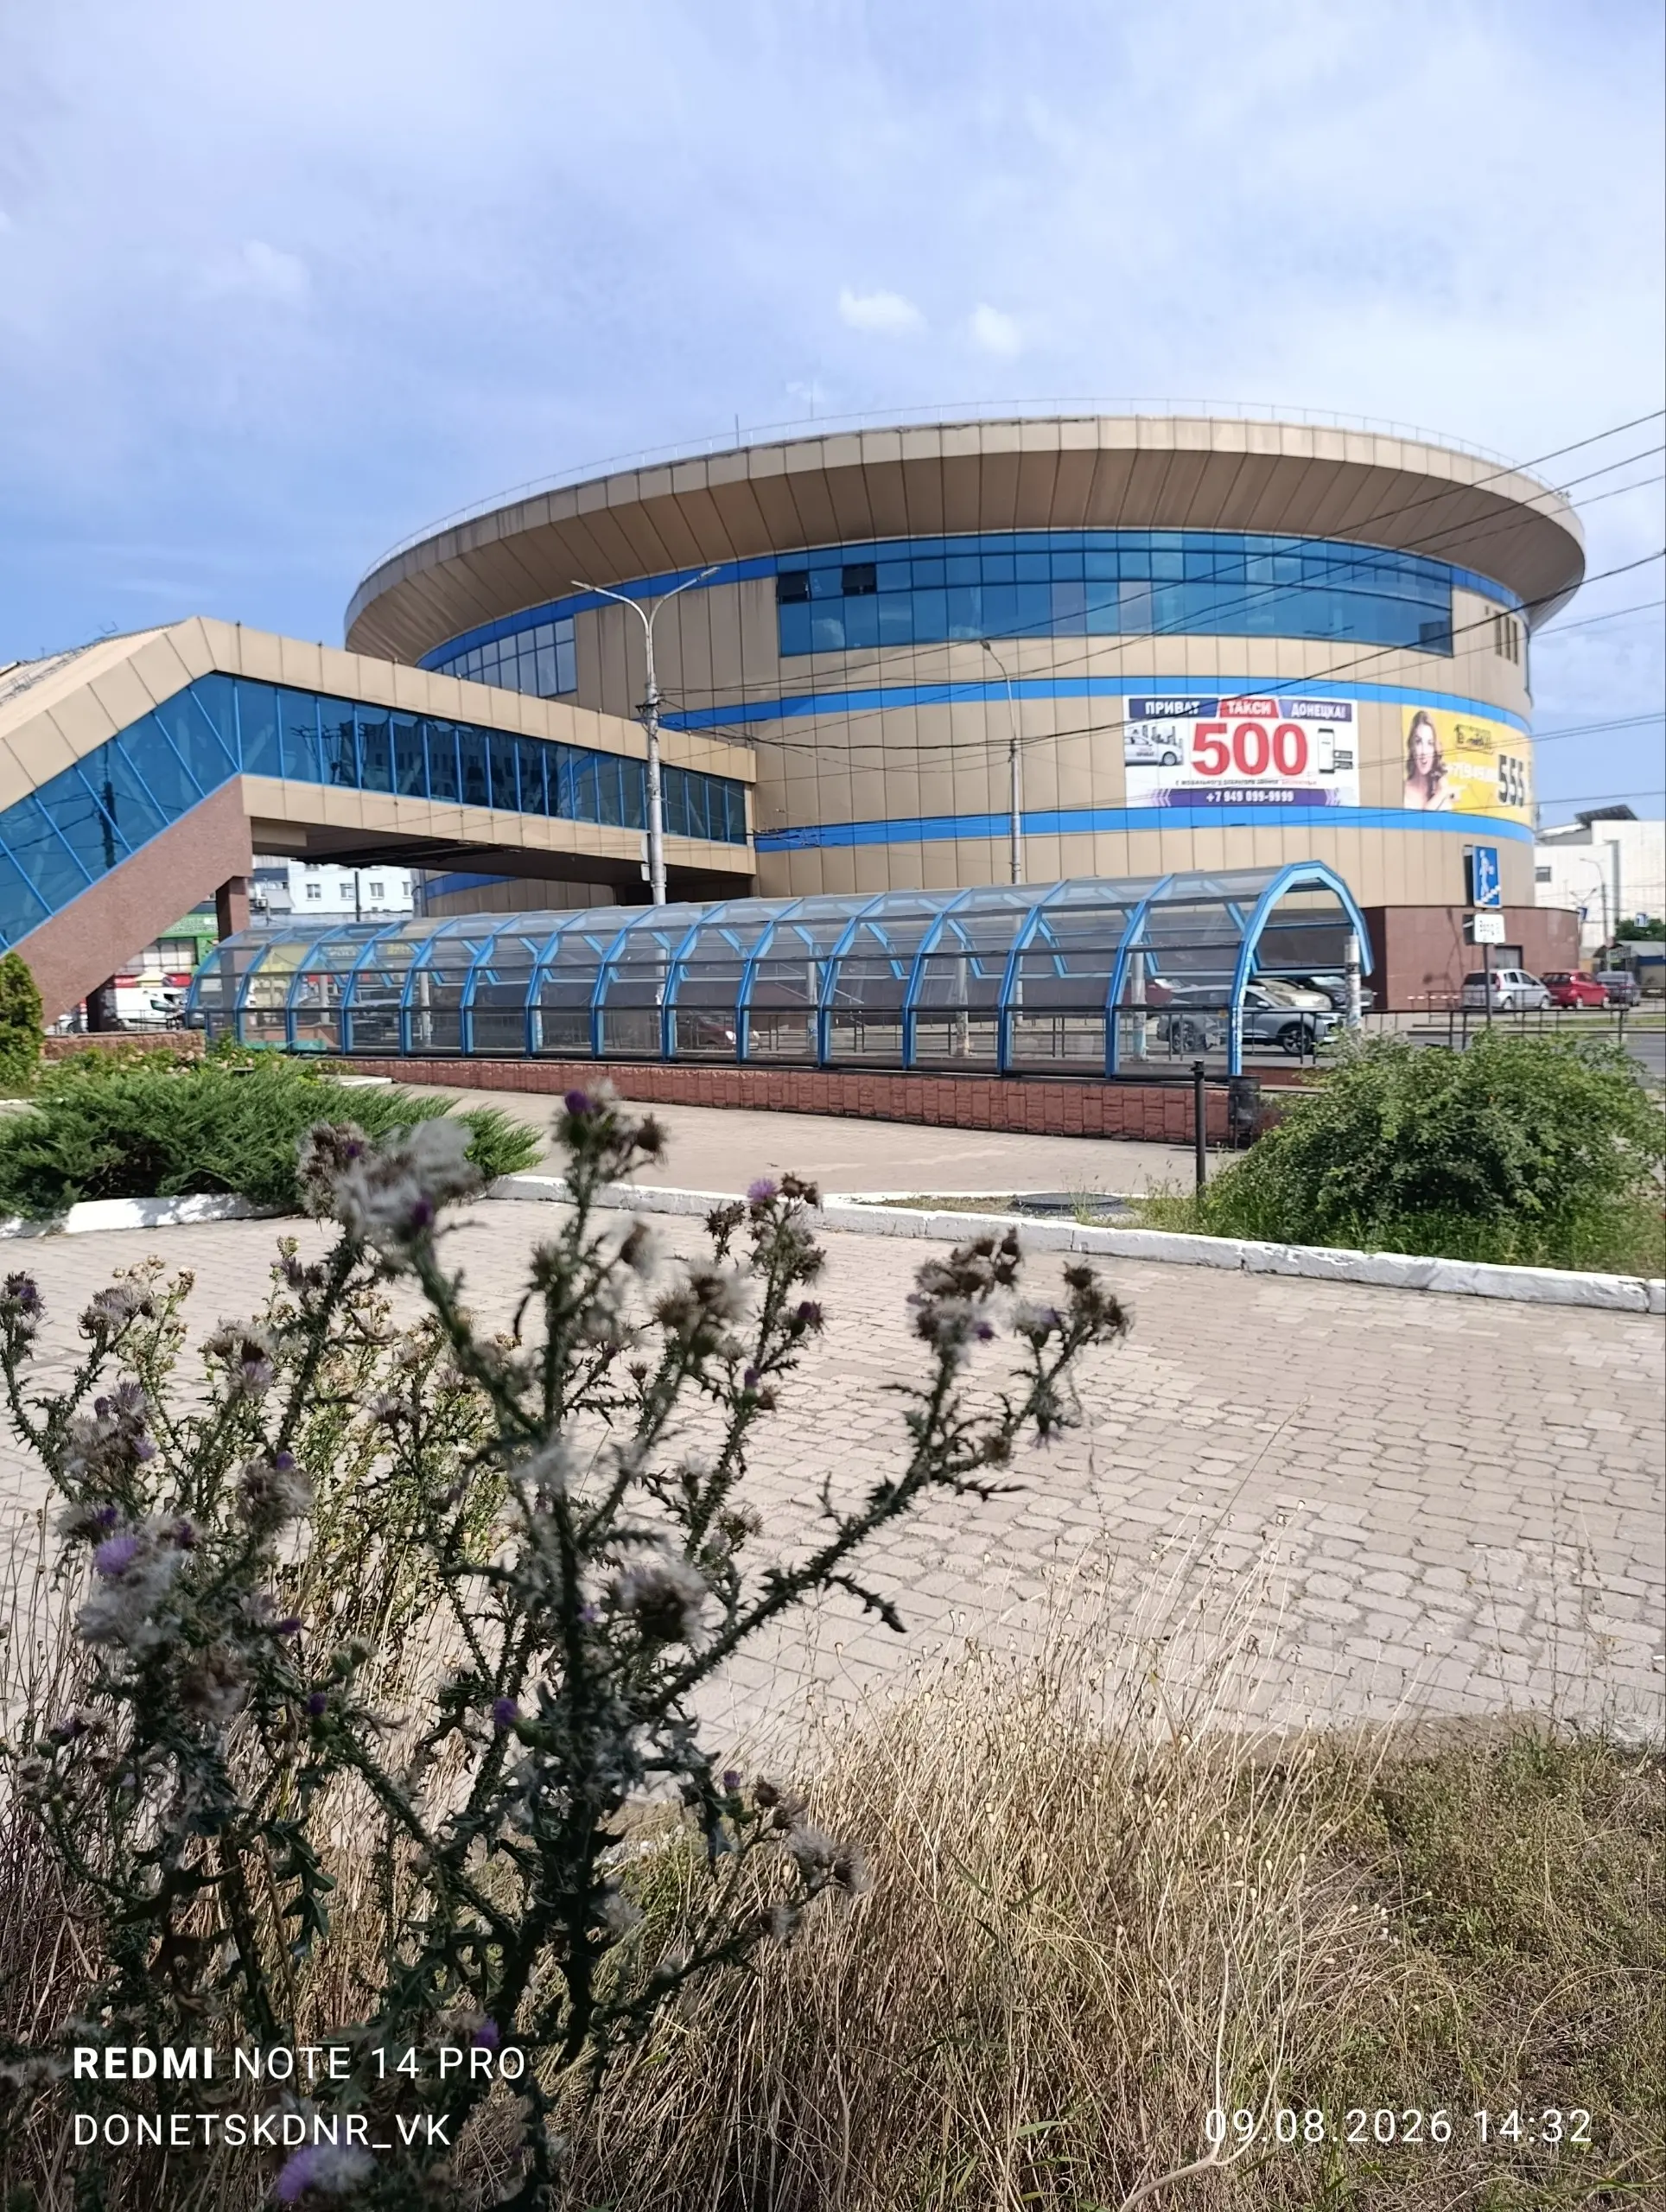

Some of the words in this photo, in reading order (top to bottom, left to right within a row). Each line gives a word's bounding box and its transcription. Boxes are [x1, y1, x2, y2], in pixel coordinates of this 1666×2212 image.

[1145, 701, 1200, 715] ПРИВАТ
[1228, 702, 1272, 715] ТАКСИ
[1291, 703, 1346, 719] ДОНЕЦКА!
[1191, 722, 1308, 776] 500
[1206, 791, 1222, 803] +7
